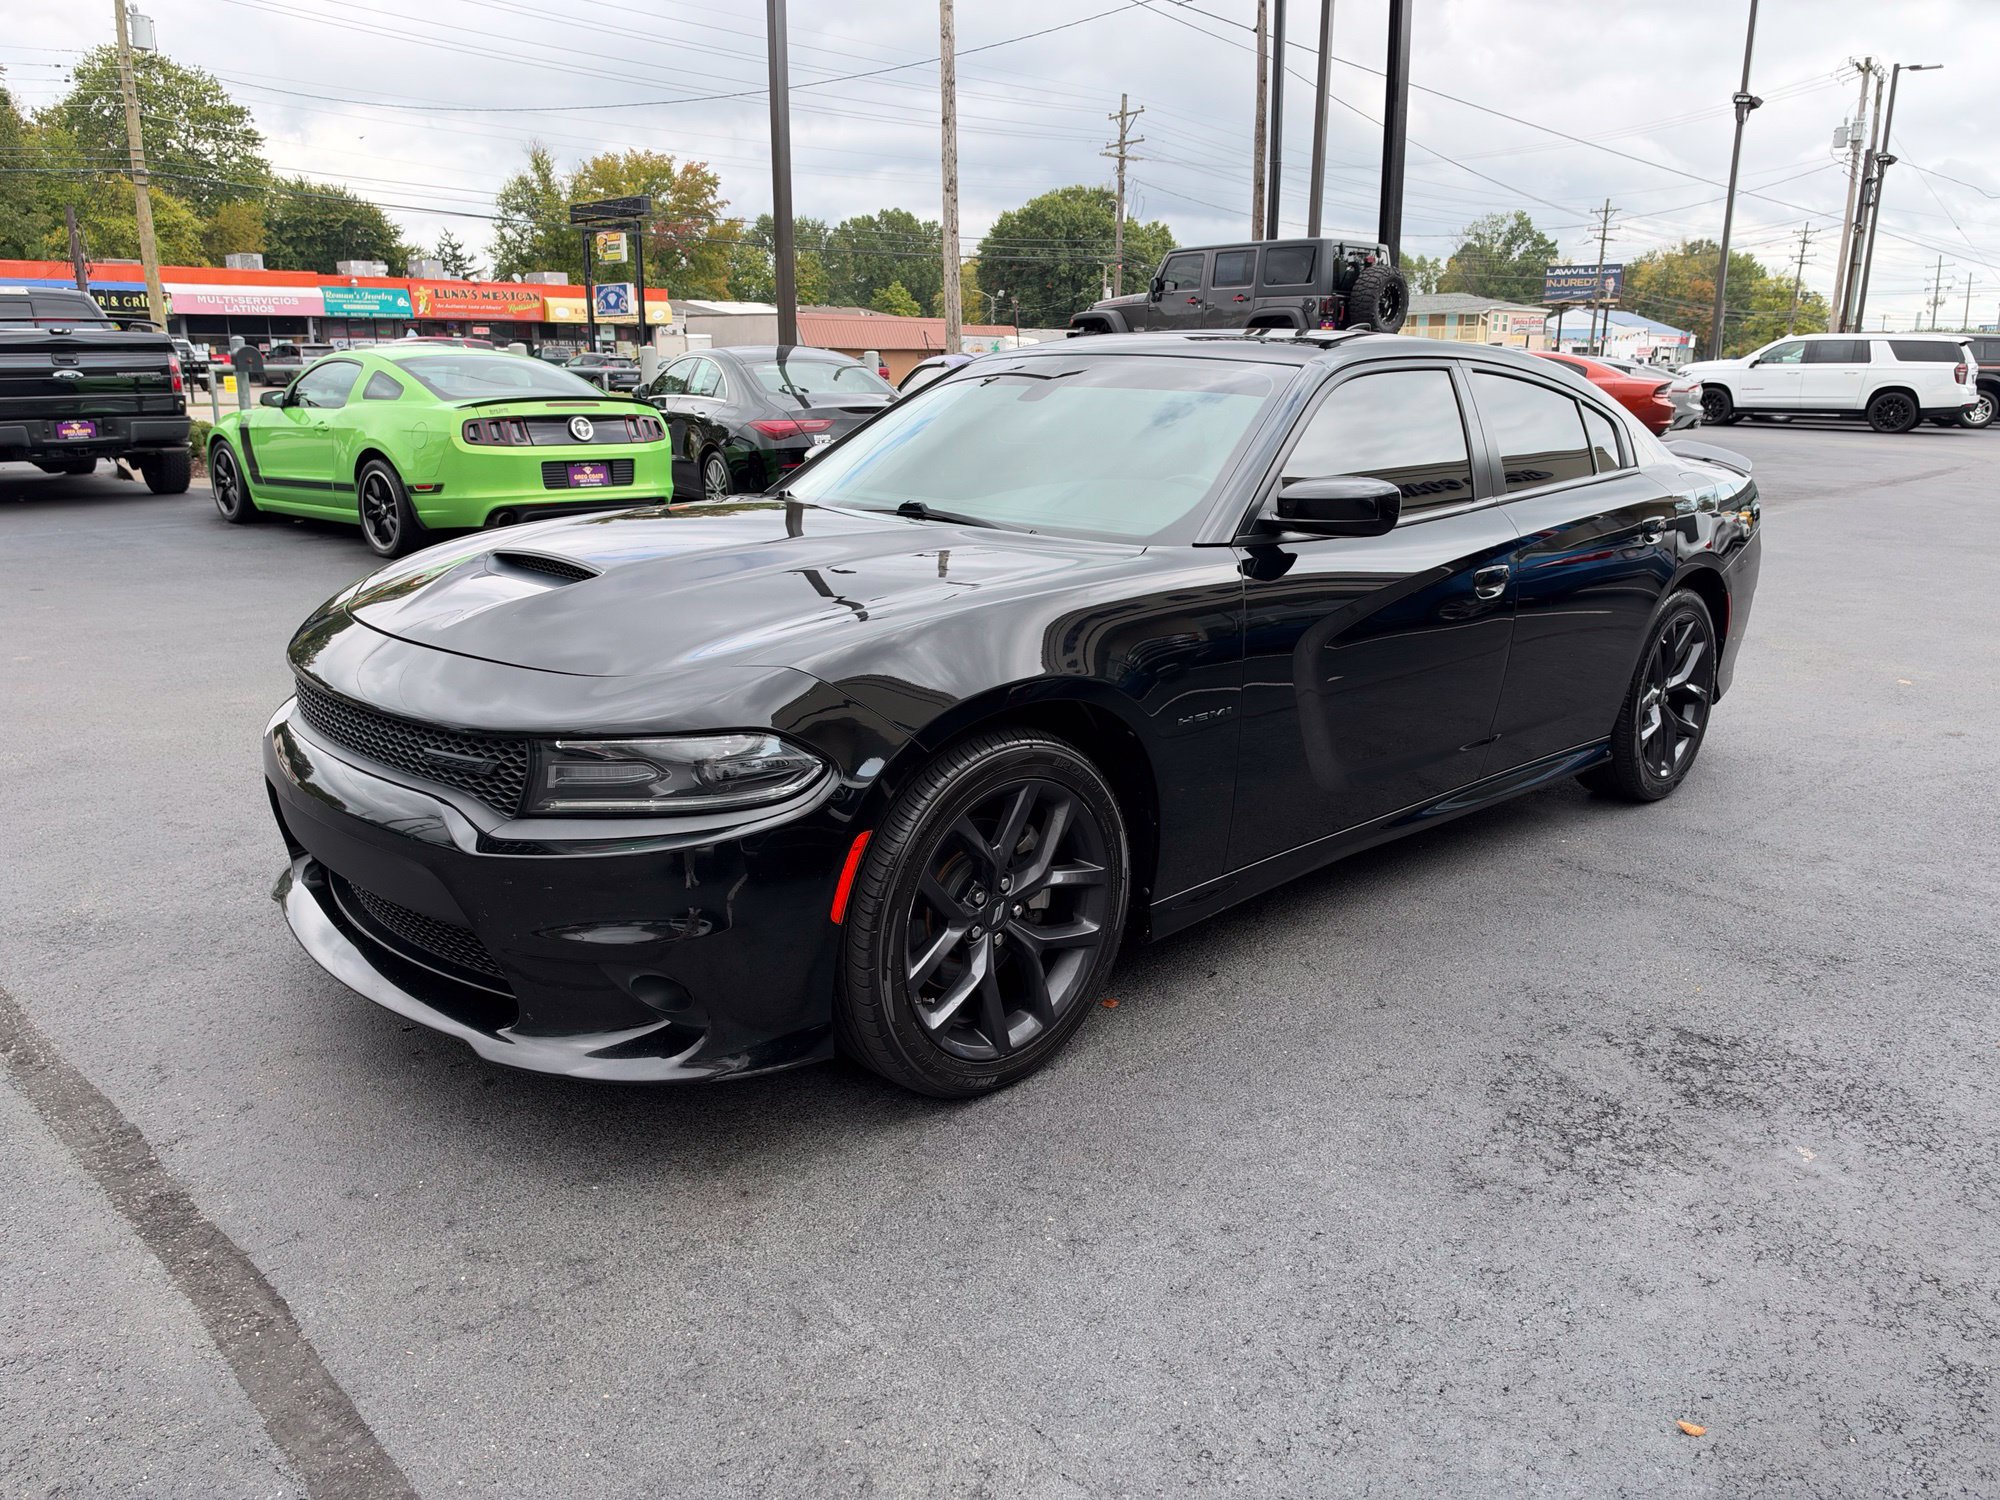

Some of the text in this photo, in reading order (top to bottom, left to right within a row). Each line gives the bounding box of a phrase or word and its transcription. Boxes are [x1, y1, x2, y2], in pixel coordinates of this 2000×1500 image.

[1546, 277, 1598, 288] INJURED?
[361, 291, 393, 302] Jewelry
[434, 288, 541, 302] LUNA'S MEXICAN
[224, 304, 275, 313] LATINOS
[1177, 706, 1233, 726] HEMI
